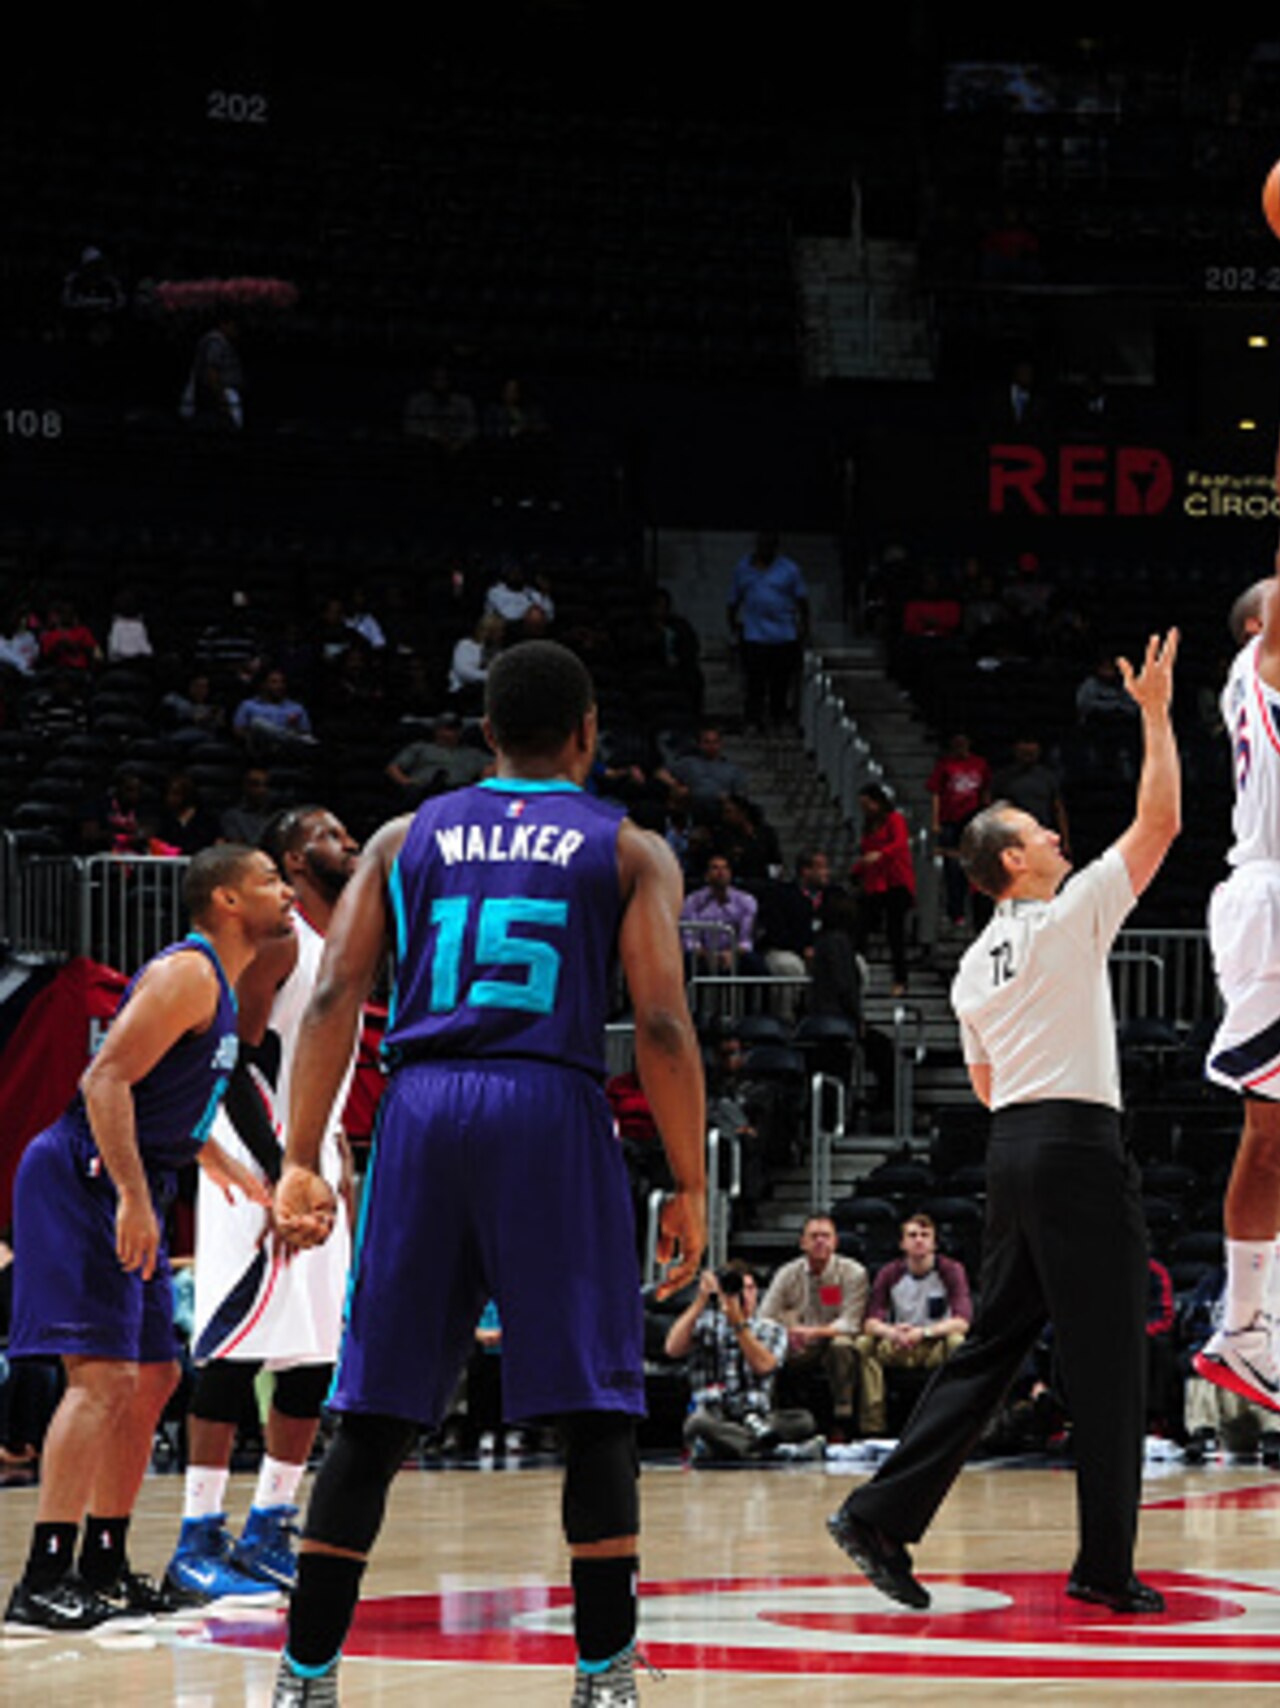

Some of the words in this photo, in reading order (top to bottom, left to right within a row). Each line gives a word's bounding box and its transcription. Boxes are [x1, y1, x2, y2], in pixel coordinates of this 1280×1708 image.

[207, 92, 269, 123] 202
[3, 409, 63, 439] 108
[435, 824, 585, 869] WALKER
[428, 895, 568, 1016] 15
